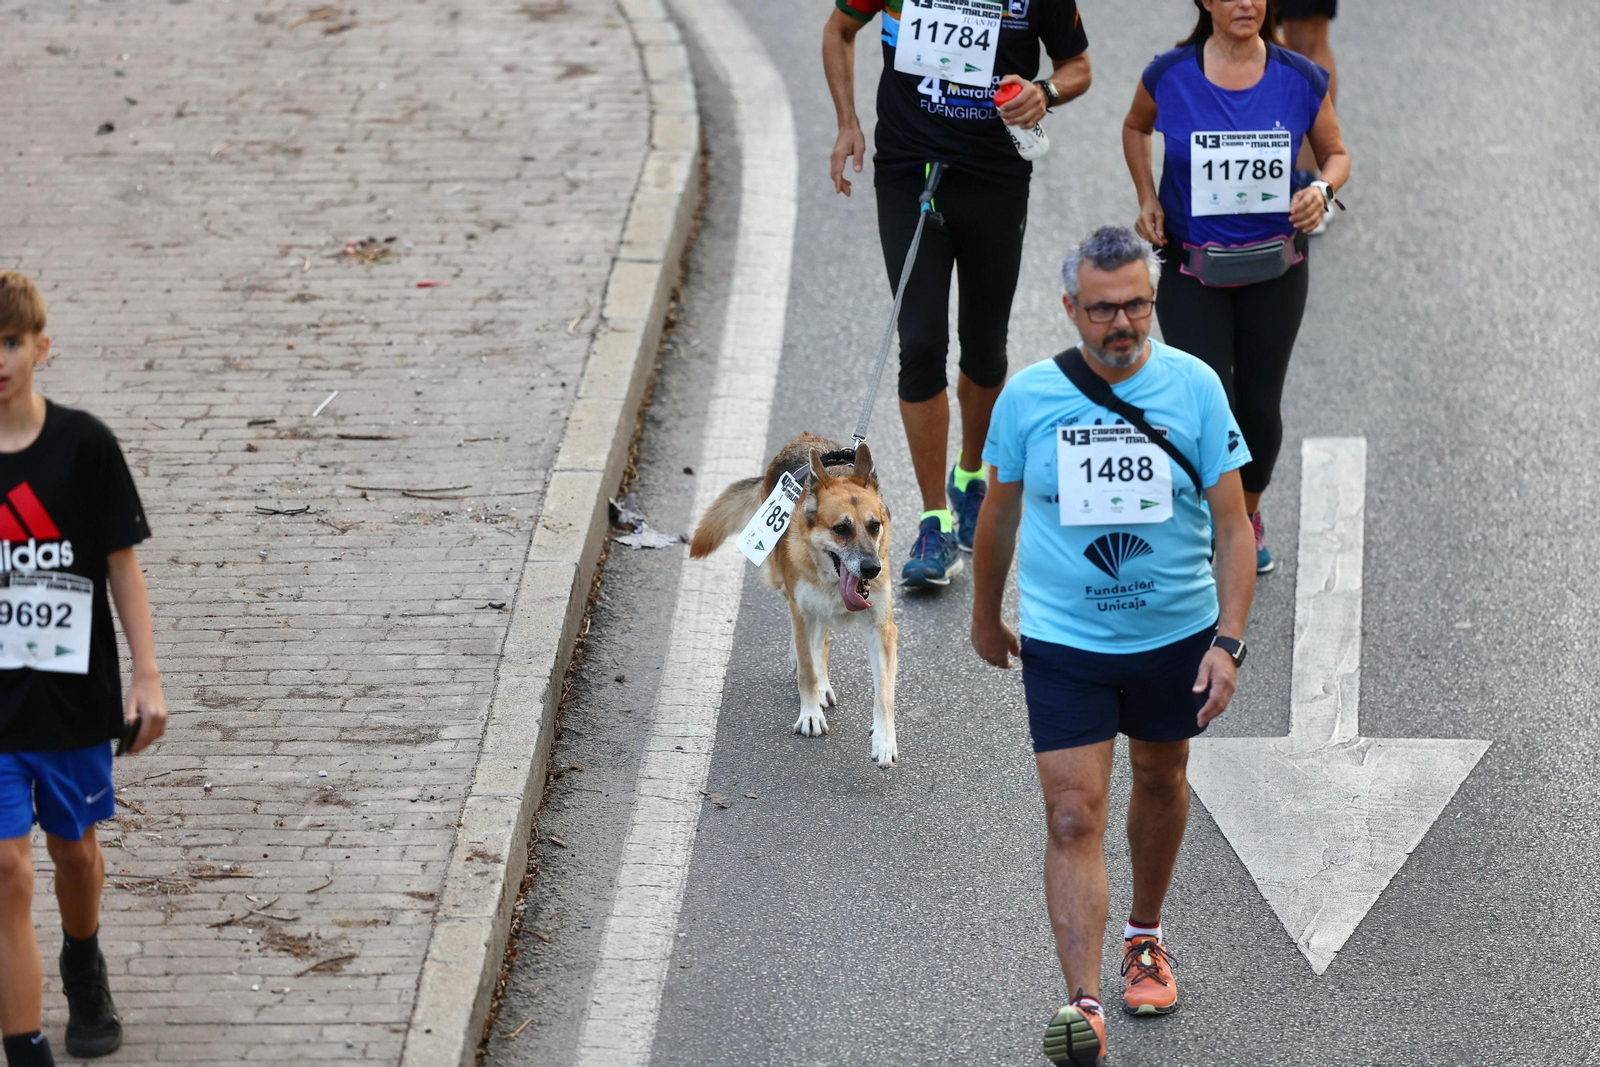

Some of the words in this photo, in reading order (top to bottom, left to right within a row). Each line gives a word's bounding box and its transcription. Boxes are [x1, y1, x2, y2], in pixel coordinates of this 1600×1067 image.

[962, 7, 1001, 20] MALAGA
[910, 17, 990, 51] 11784
[946, 82, 997, 99] Marató
[1195, 134, 1221, 149] 43
[1251, 140, 1290, 149] MALAGA
[1202, 158, 1284, 181] 11786
[1061, 429, 1091, 446] 43
[1079, 456, 1154, 483] 1488
[0, 538, 74, 572] idas
[1085, 580, 1155, 596] Fundación
[1097, 597, 1147, 612] Unicaja
[0, 600, 73, 629] 9692
